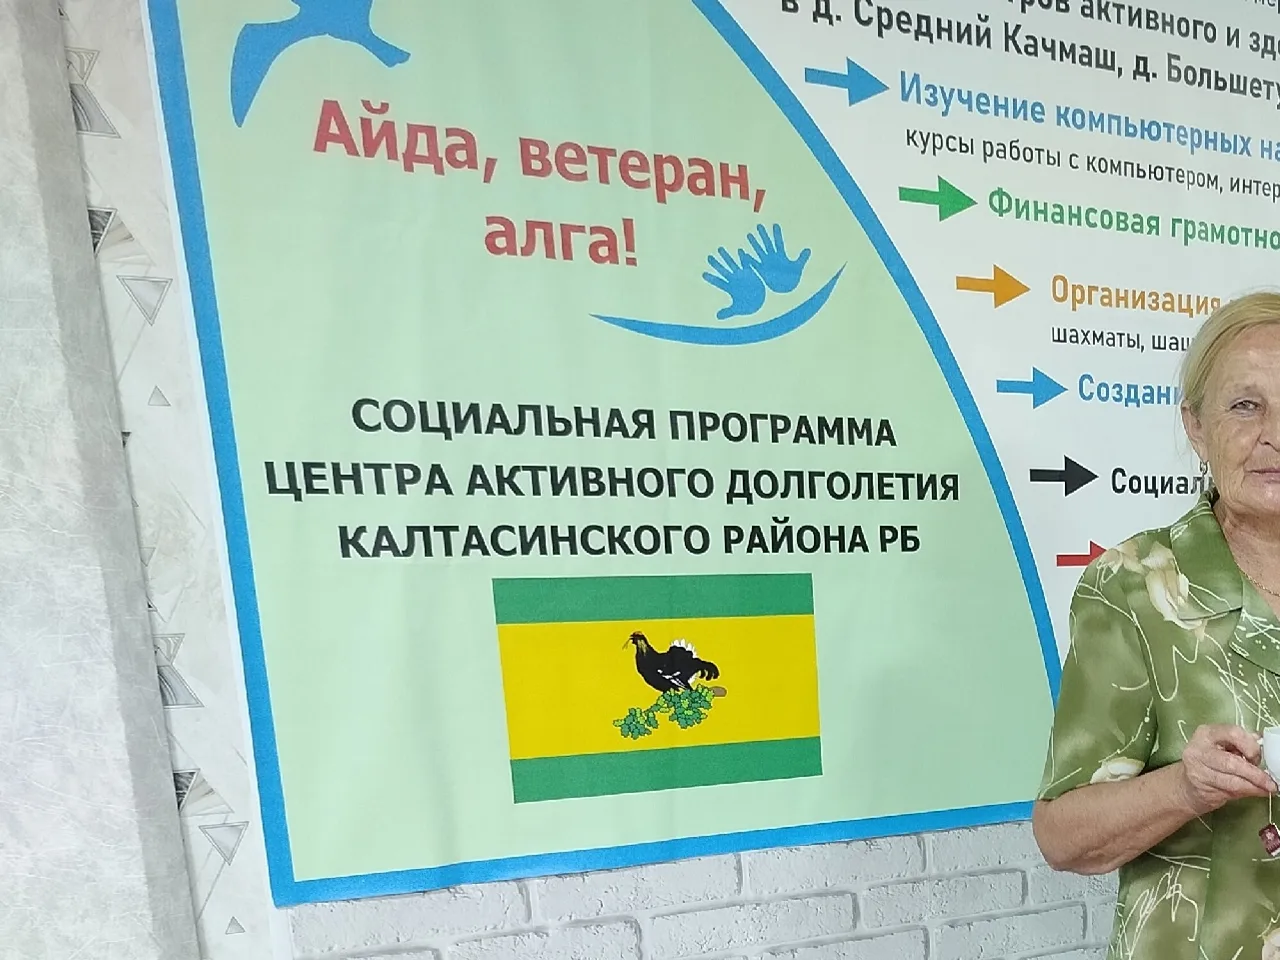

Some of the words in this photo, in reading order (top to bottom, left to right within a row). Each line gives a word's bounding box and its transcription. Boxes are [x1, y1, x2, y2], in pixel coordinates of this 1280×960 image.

[812, 0, 842, 27] д.
[854, 0, 993, 50] Средний
[1003, 20, 1123, 78] Качмаш,
[1133, 53, 1158, 82] д.
[1080, 0, 1217, 43] активного
[1225, 26, 1240, 49] и
[900, 70, 1045, 124] Изучение
[1056, 104, 1252, 157] компьютерных
[312, 98, 498, 184] Айда,
[518, 136, 767, 213] ветеран,
[906, 127, 975, 157] курсы
[982, 138, 1061, 168] работы
[1068, 152, 1080, 170] с
[1086, 154, 1224, 194] компьютером,
[988, 186, 1161, 237] Финансовая
[484, 213, 640, 268] алга!
[1051, 326, 1146, 353] шахматы,
[351, 397, 657, 440] СОЦИАЛЬНАЯ
[669, 410, 898, 448] ПРОГРАММА
[264, 459, 453, 498] ЦЕНТРА
[465, 463, 715, 500] АКТИВНОГО
[726, 468, 961, 505] ДОЛГОЛЕТИЯ
[338, 523, 712, 559] КАЛТАСИНСКОГО
[723, 516, 870, 555] РАЙОНА
[878, 525, 921, 554] РБ
